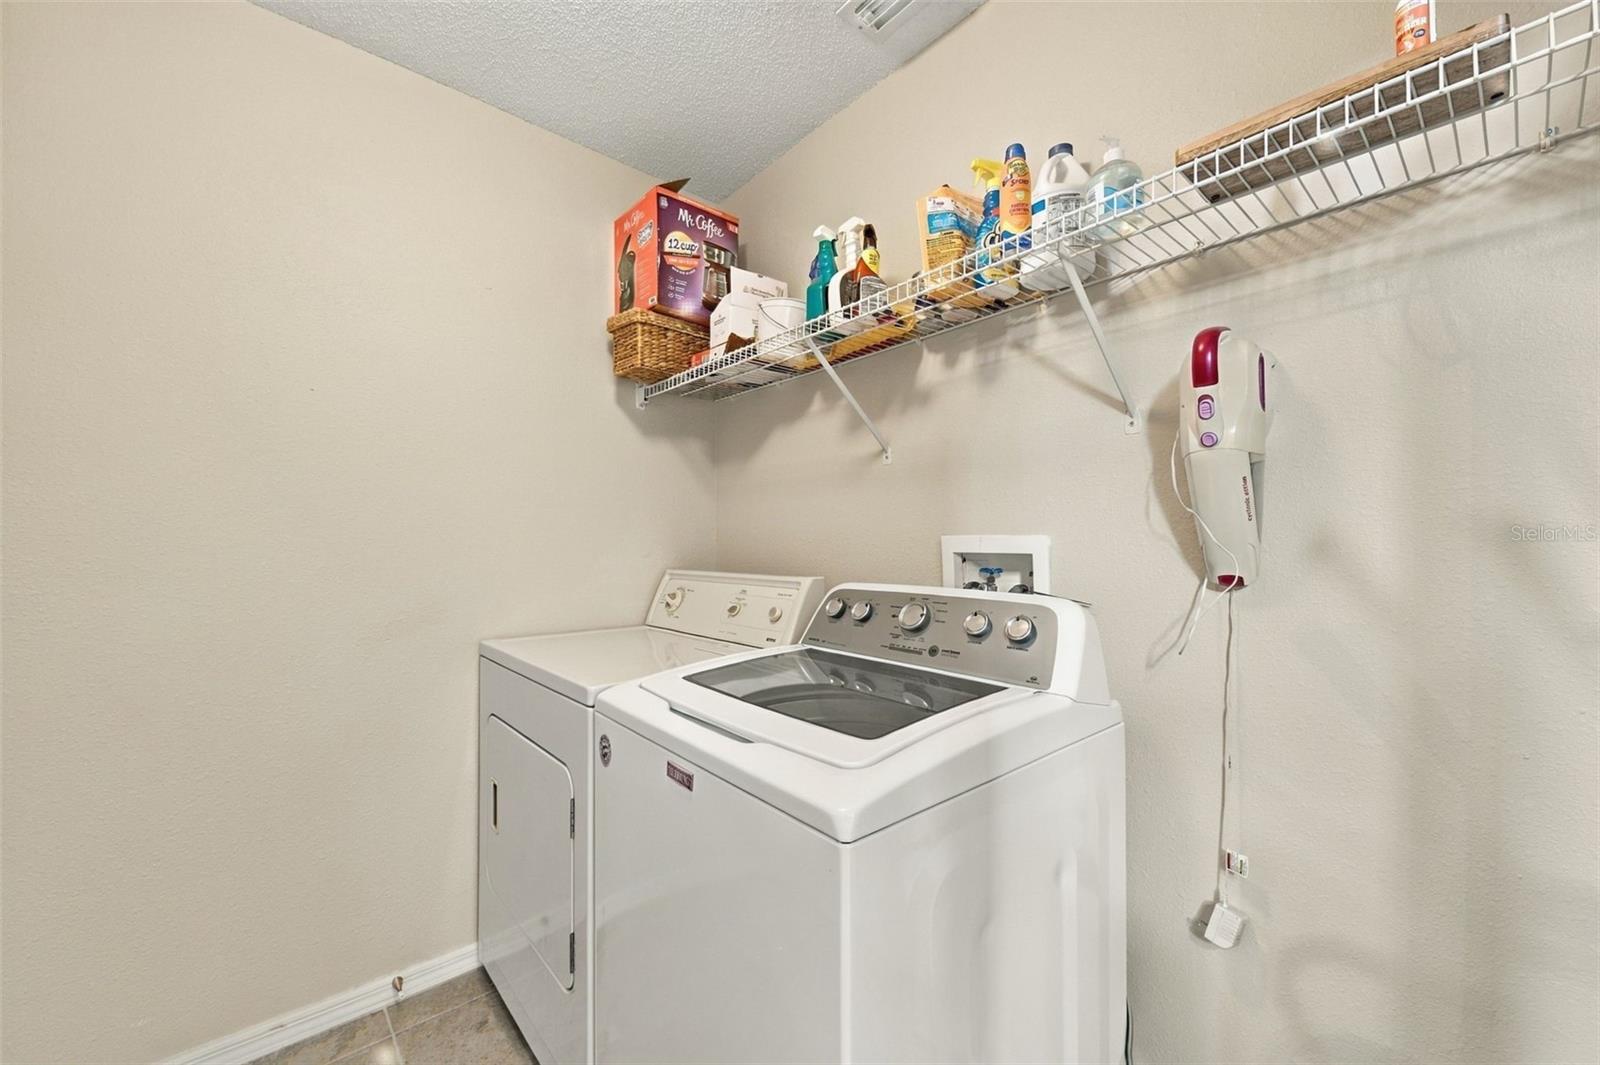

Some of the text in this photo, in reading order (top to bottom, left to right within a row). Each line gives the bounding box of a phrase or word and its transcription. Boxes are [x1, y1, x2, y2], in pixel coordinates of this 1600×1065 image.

[695, 214, 724, 238] Coffee
[668, 238, 698, 254] 12 cup
